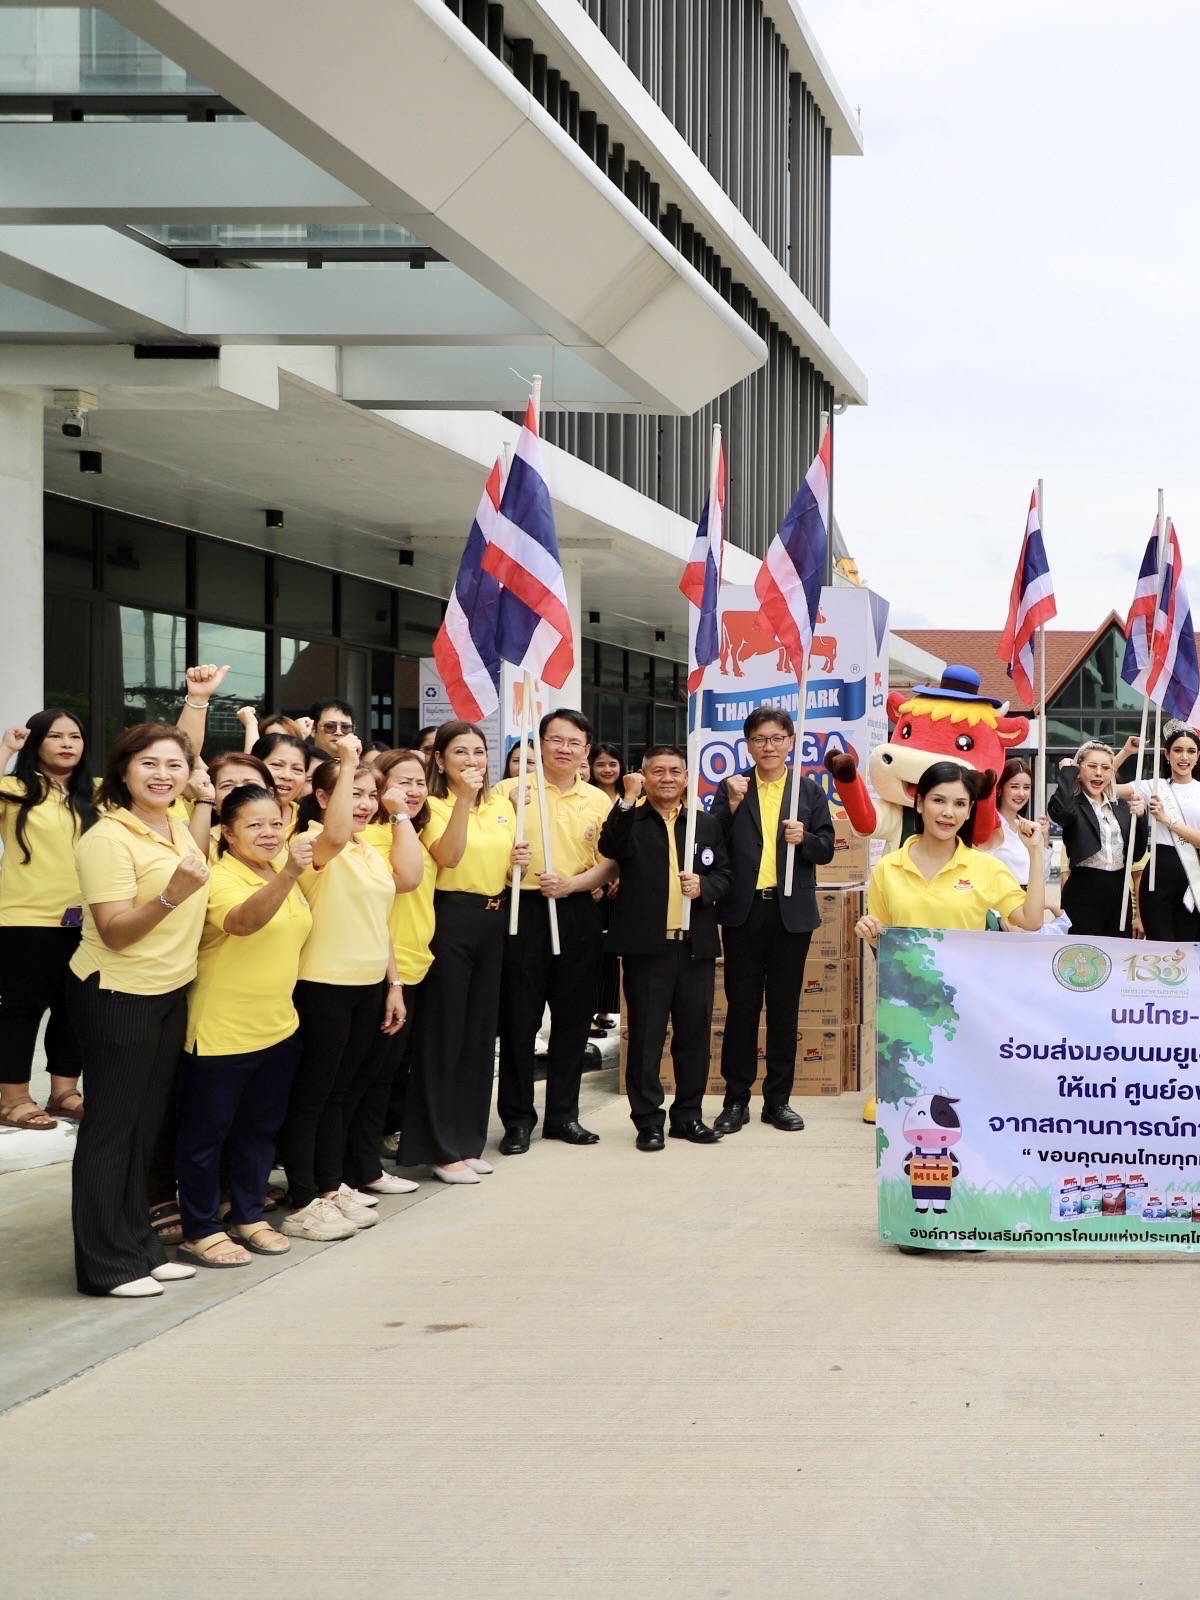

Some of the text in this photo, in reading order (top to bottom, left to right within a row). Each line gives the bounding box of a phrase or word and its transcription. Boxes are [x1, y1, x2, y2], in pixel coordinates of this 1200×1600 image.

[1057, 1075, 1117, 1098] ให้แก่
[913, 1171, 949, 1182] MILK
